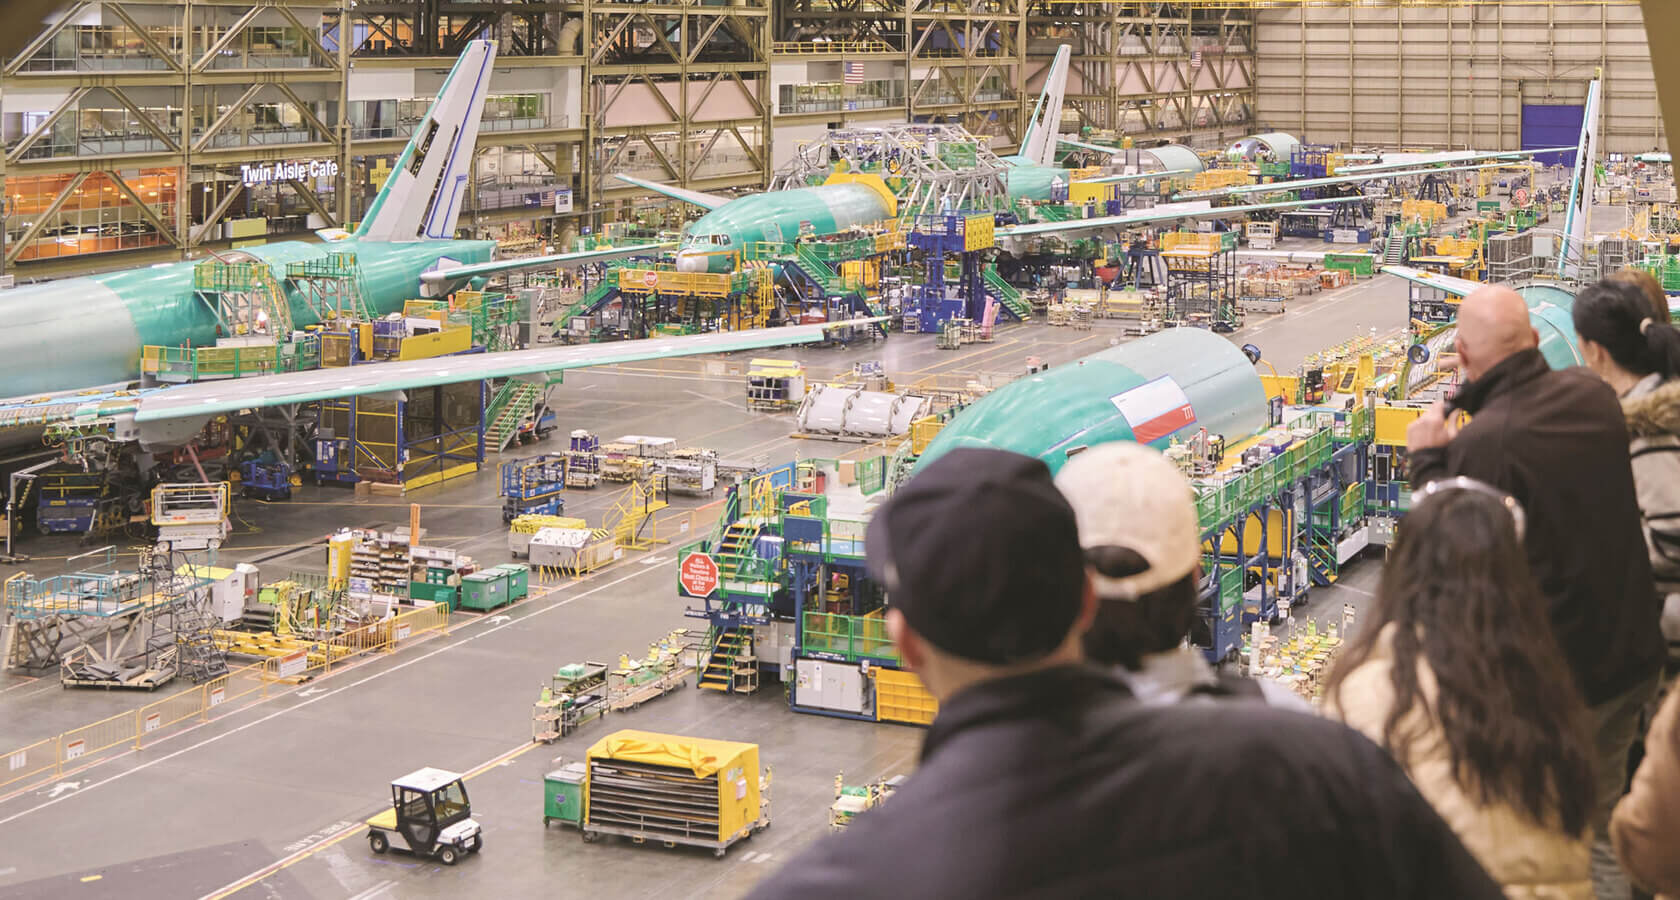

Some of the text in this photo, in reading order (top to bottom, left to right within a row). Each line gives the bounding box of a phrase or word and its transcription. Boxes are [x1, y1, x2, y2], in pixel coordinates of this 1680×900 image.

[241, 159, 338, 182] Twin Aisle Cafe
